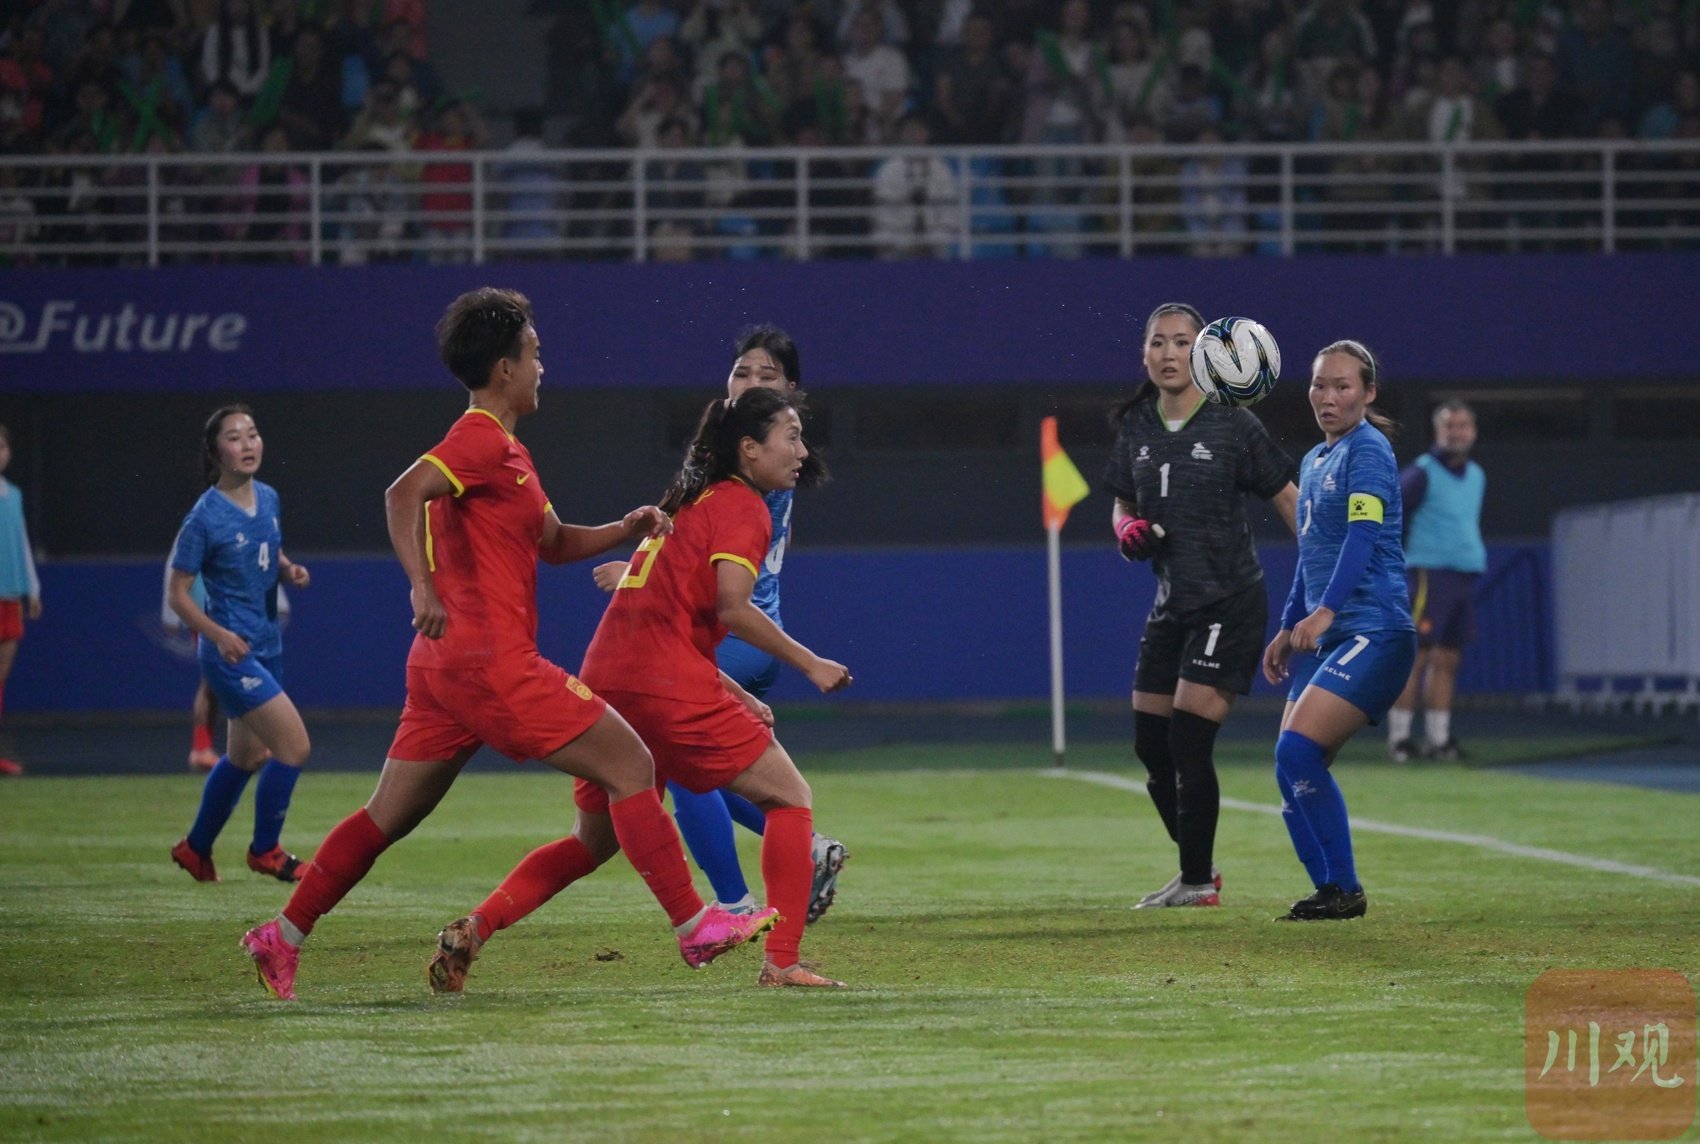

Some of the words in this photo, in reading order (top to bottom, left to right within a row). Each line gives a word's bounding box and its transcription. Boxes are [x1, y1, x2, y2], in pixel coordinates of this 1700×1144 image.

[1159, 463, 1171, 497] 1
[258, 541, 270, 572] 4
[1204, 623, 1222, 657] 1
[1336, 634, 1370, 666] 7
[1192, 658, 1221, 669] KELME
[1324, 666, 1352, 681] KELME
